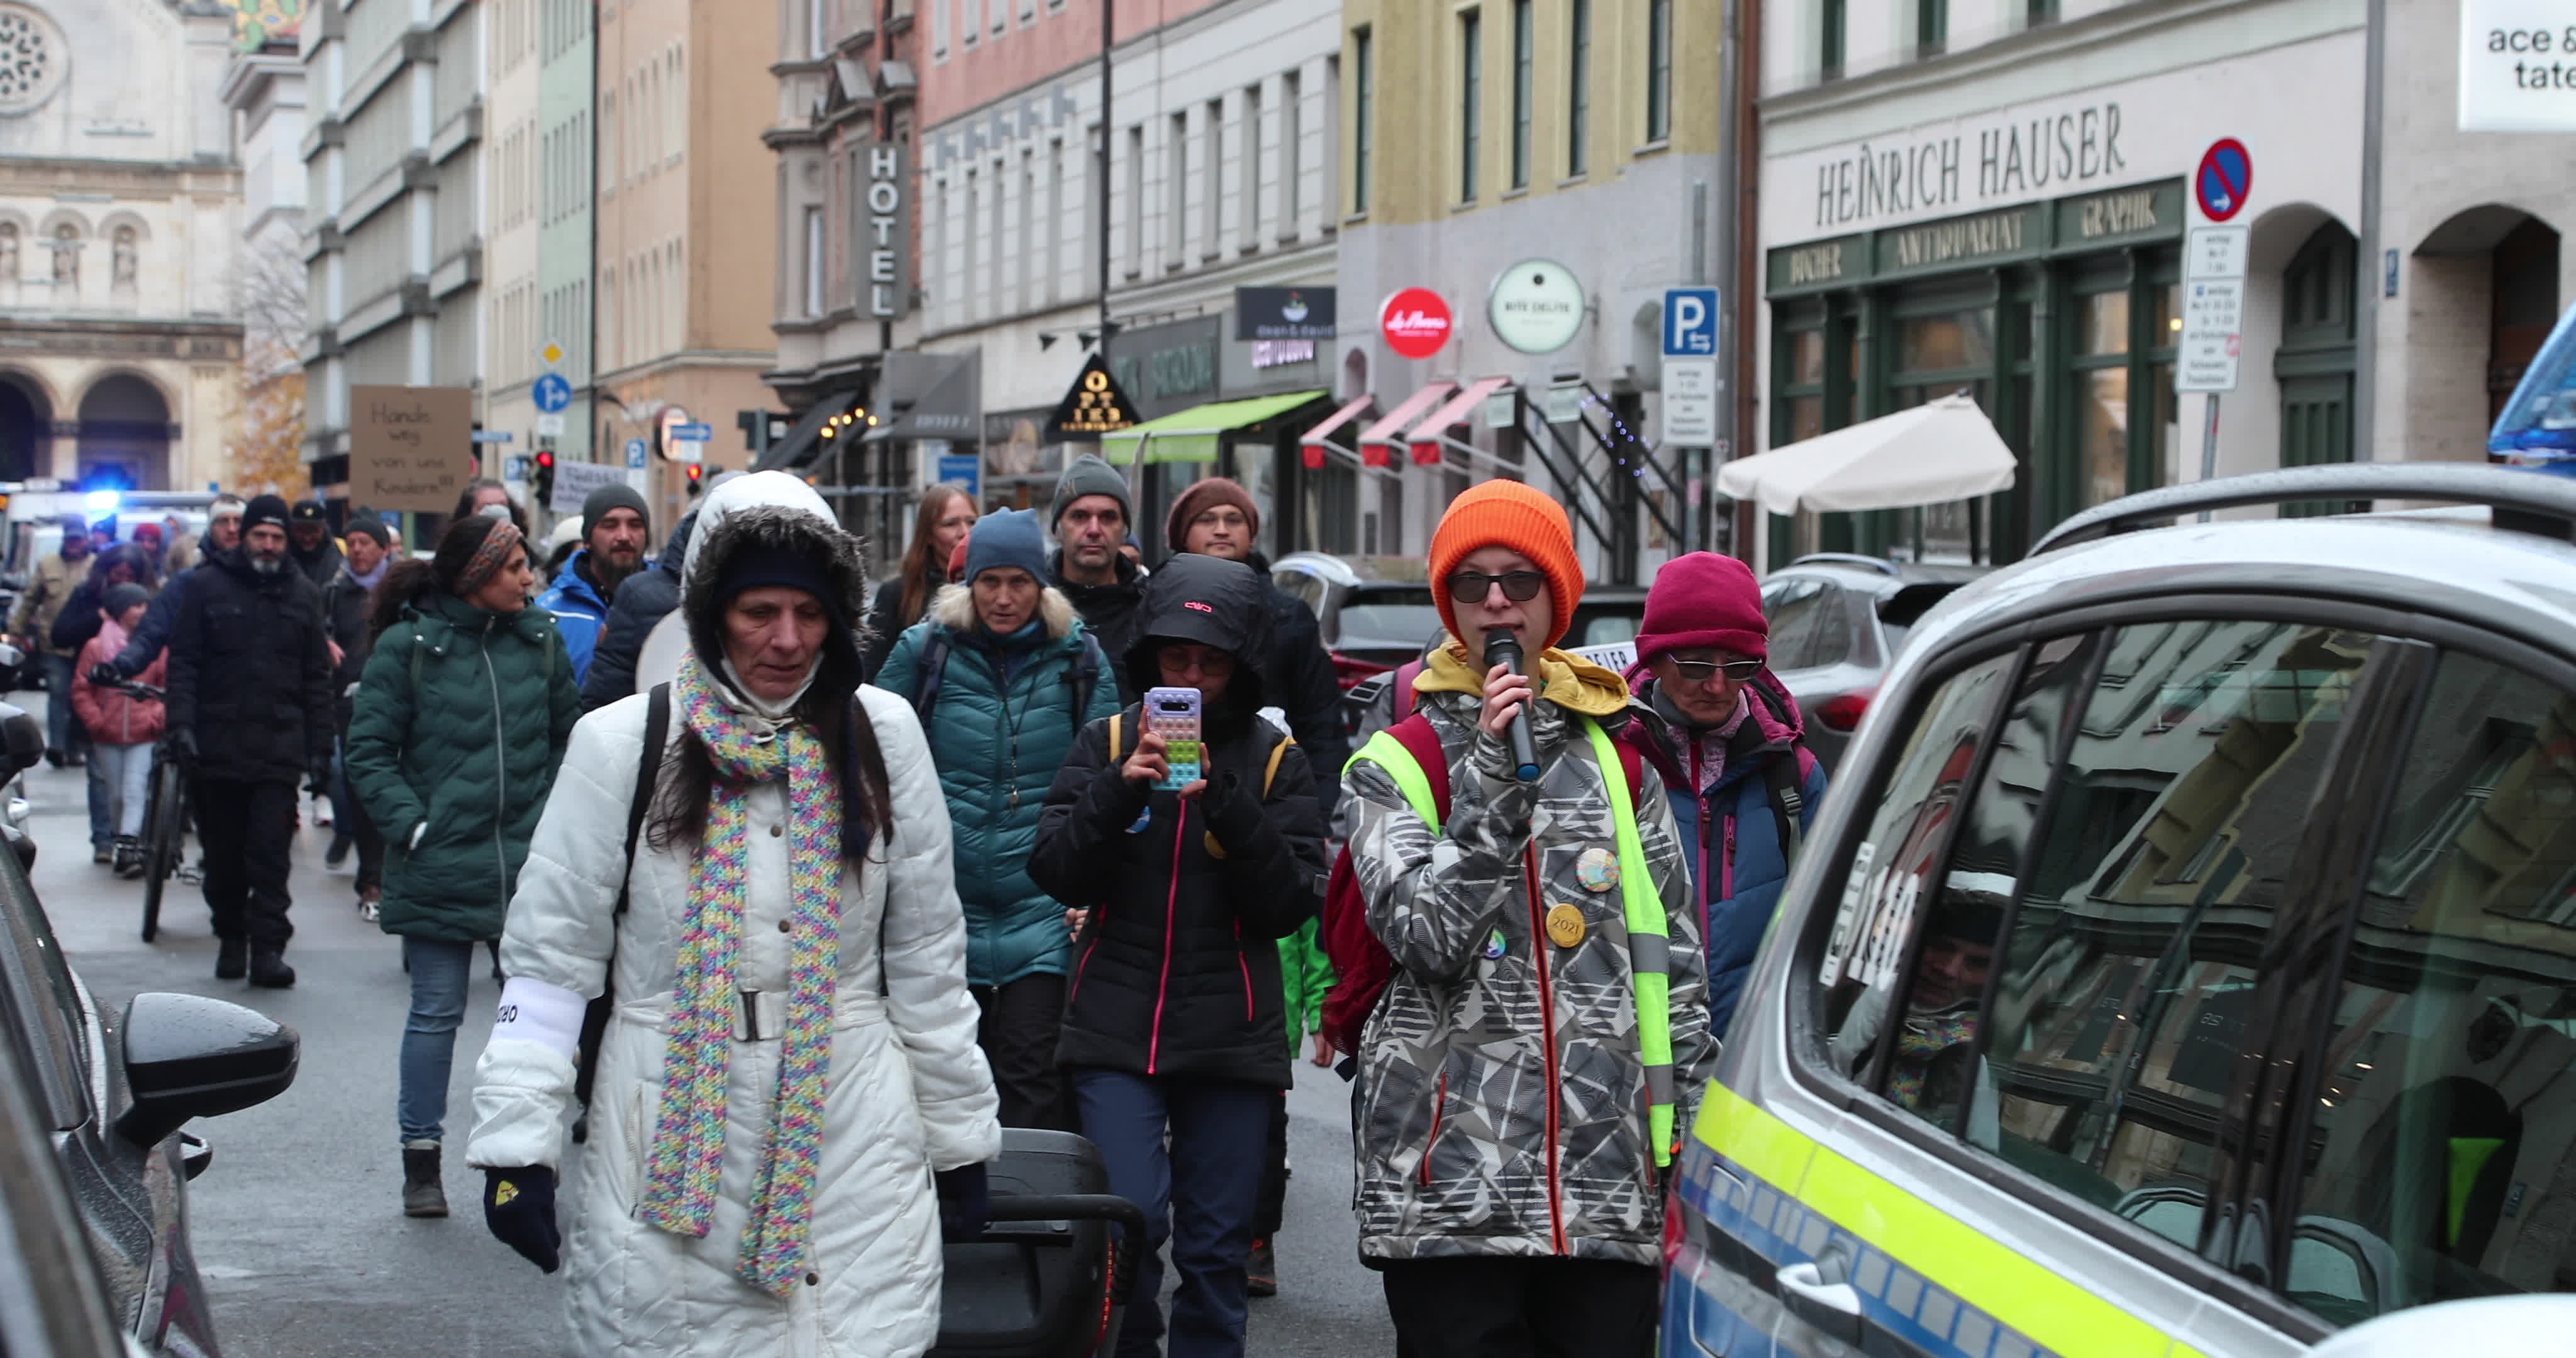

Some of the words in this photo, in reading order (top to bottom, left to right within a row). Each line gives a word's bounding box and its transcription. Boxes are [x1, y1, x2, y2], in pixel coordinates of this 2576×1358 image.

[2488, 28, 2552, 53] ace
[2514, 60, 2576, 89] tate
[1816, 136, 1961, 227] HEINRICH
[1979, 102, 2126, 197] HAUSER
[867, 147, 899, 316] HOTEL
[2082, 190, 2158, 238] GRAPHIK
[1674, 295, 1706, 350] P
[1553, 915, 1580, 936] 2021
